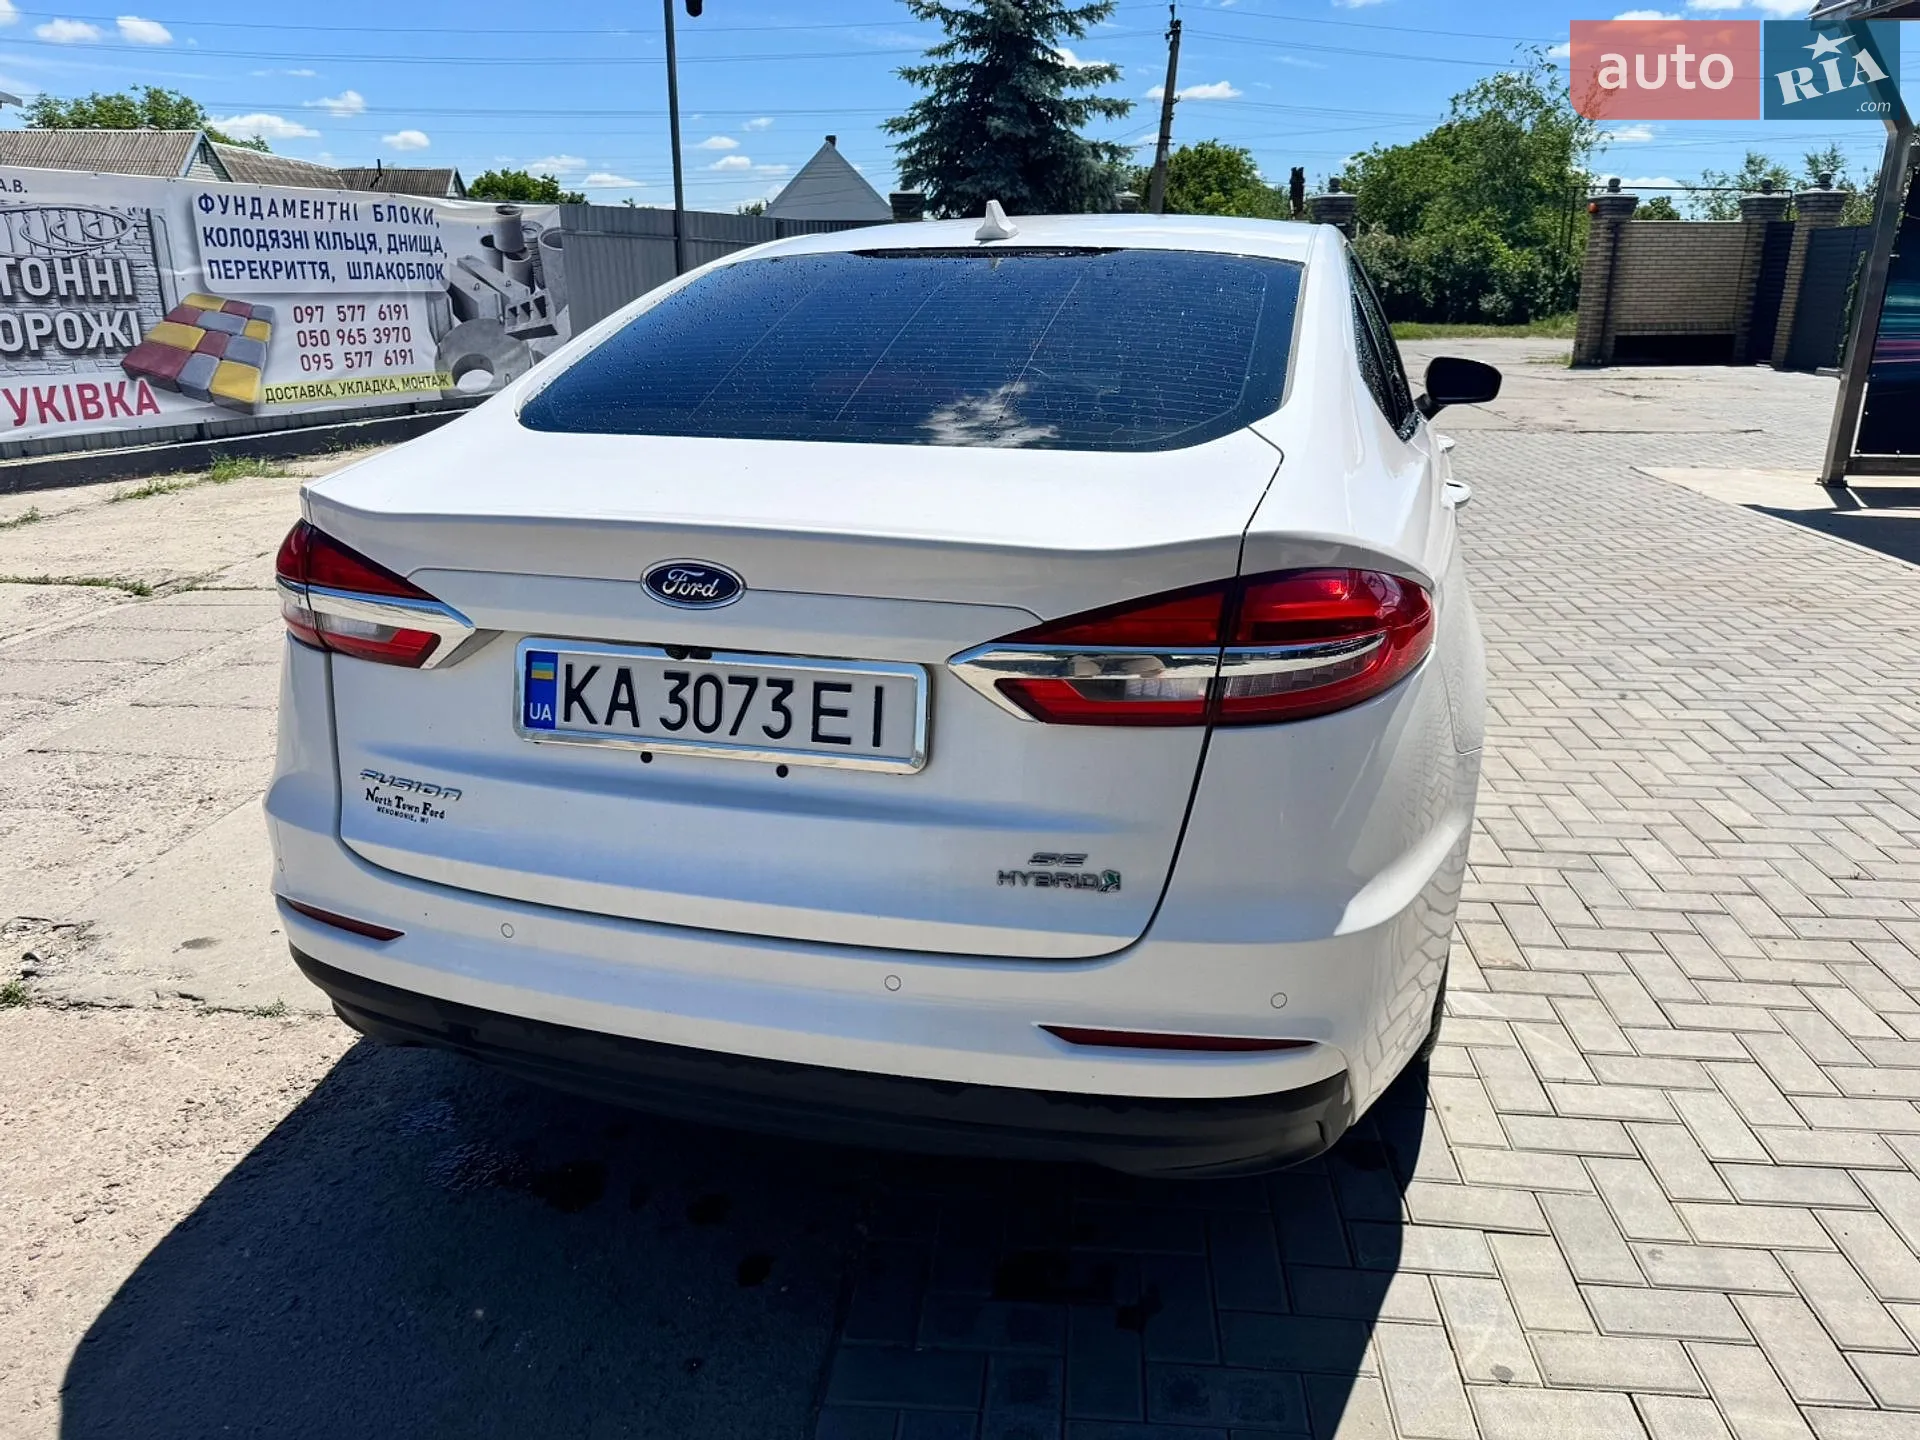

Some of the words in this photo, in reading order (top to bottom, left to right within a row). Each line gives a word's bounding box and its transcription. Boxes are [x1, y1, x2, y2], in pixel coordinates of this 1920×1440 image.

[199, 193, 359, 222] ФУНДАМЕНТНІ
[373, 204, 441, 228] БЛОКИ,
[203, 227, 310, 251] КОЛОДЯЗНІ
[315, 231, 382, 254] КІЛЬЦЯ,
[387, 234, 448, 258] ДНИЩА,
[208, 259, 336, 283] ПЕРЕКРИТТЯ,
[347, 262, 445, 281] ШЛАКОБЛОК
[293, 305, 324, 324] 097
[337, 304, 365, 323] 577
[378, 303, 409, 321] 6191
[0, 311, 142, 352] ОРОЖІ
[297, 329, 330, 348] 050
[336, 328, 367, 346] 965
[373, 326, 411, 344] 3970
[301, 353, 334, 372] 095
[344, 351, 373, 369] 577
[384, 349, 415, 367] 6191
[1, 380, 161, 427] УКІВКА
[265, 384, 337, 404] ДОСТАВКА,
[339, 378, 400, 396] УКЛАДКА,
[401, 374, 450, 390] МОНТАЖ
[662, 569, 720, 597] Ford
[529, 702, 552, 721] UA
[563, 663, 640, 728] KA
[659, 670, 795, 740] 3073
[811, 681, 884, 748] EI
[360, 768, 462, 801] FUSION
[365, 786, 393, 807] North
[395, 795, 420, 814] Town
[422, 802, 445, 819] Ford
[1028, 852, 1088, 867] SE
[997, 870, 1099, 889] HYBRID
